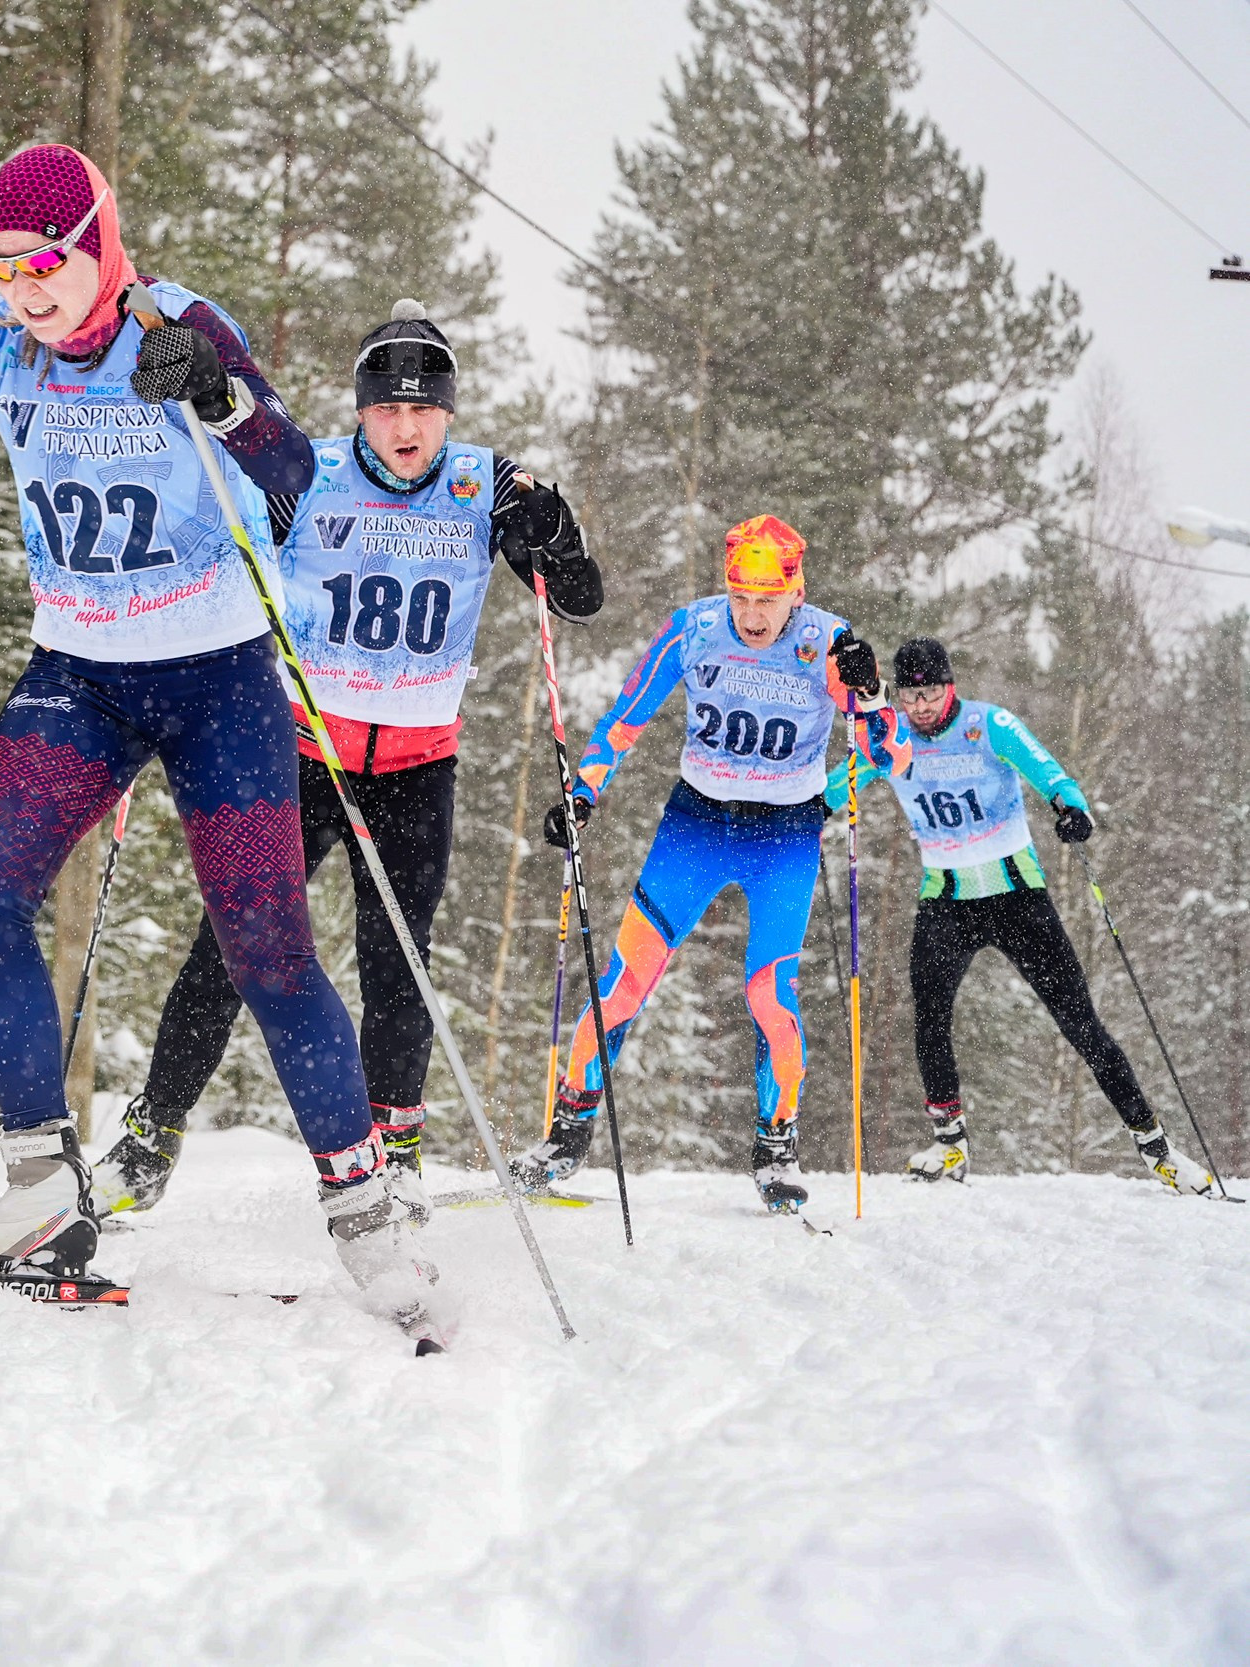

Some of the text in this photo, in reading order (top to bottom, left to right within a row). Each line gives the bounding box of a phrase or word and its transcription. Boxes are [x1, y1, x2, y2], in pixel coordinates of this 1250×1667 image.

[391, 390, 428, 398] NORDSKI
[44, 432, 168, 460] ТРИДЦАТКА
[323, 484, 350, 494] ILVES
[25, 480, 176, 574] 122
[363, 516, 474, 538] ВЫБОРГСКАЯ
[362, 536, 469, 560] ТРИДЦАТКА
[127, 563, 217, 617] Викингов!
[322, 574, 451, 655] 180
[346, 677, 384, 694] пути
[353, 669, 369, 679] по
[696, 703, 798, 761] 200
[914, 788, 985, 829] 161
[327, 1190, 370, 1213] salomon
